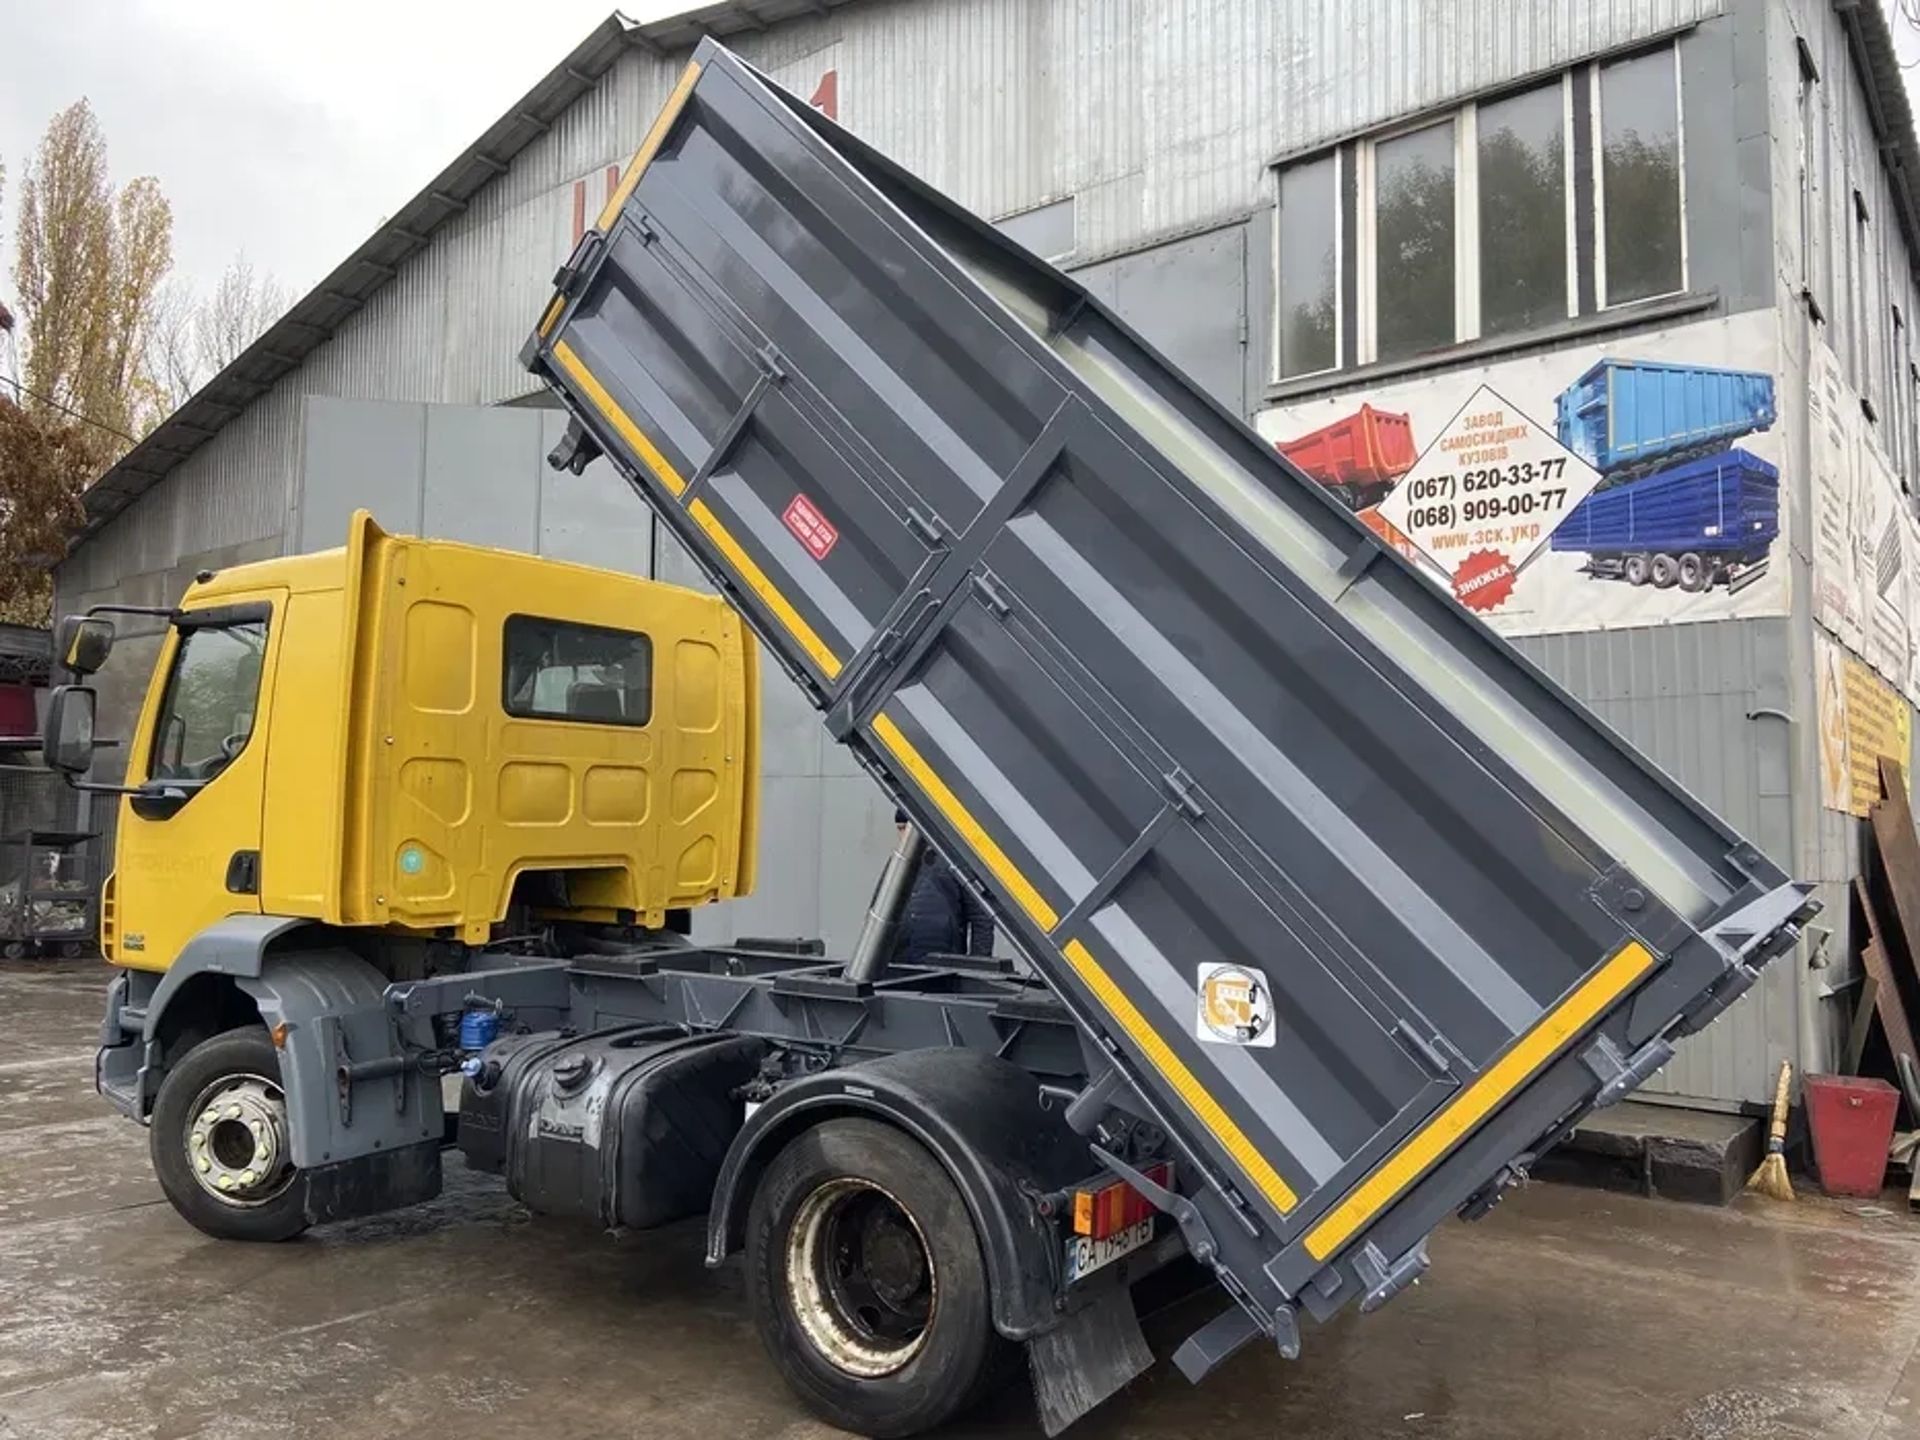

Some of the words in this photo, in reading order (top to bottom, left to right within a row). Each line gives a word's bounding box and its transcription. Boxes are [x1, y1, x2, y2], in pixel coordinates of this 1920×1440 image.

[1463, 411, 1503, 430] ЗАВОД
[1440, 425, 1528, 452] САМОСКИДНИХ
[1458, 446, 1509, 467] КУЗОВІВ
[1407, 475, 1456, 505] (067)
[1463, 458, 1567, 492] 620-33-77
[1407, 506, 1456, 533] (068)
[1463, 488, 1567, 522] 909-00-77
[1432, 523, 1540, 550] www.зск.укр
[1457, 563, 1512, 596] ЗНИЖКА
